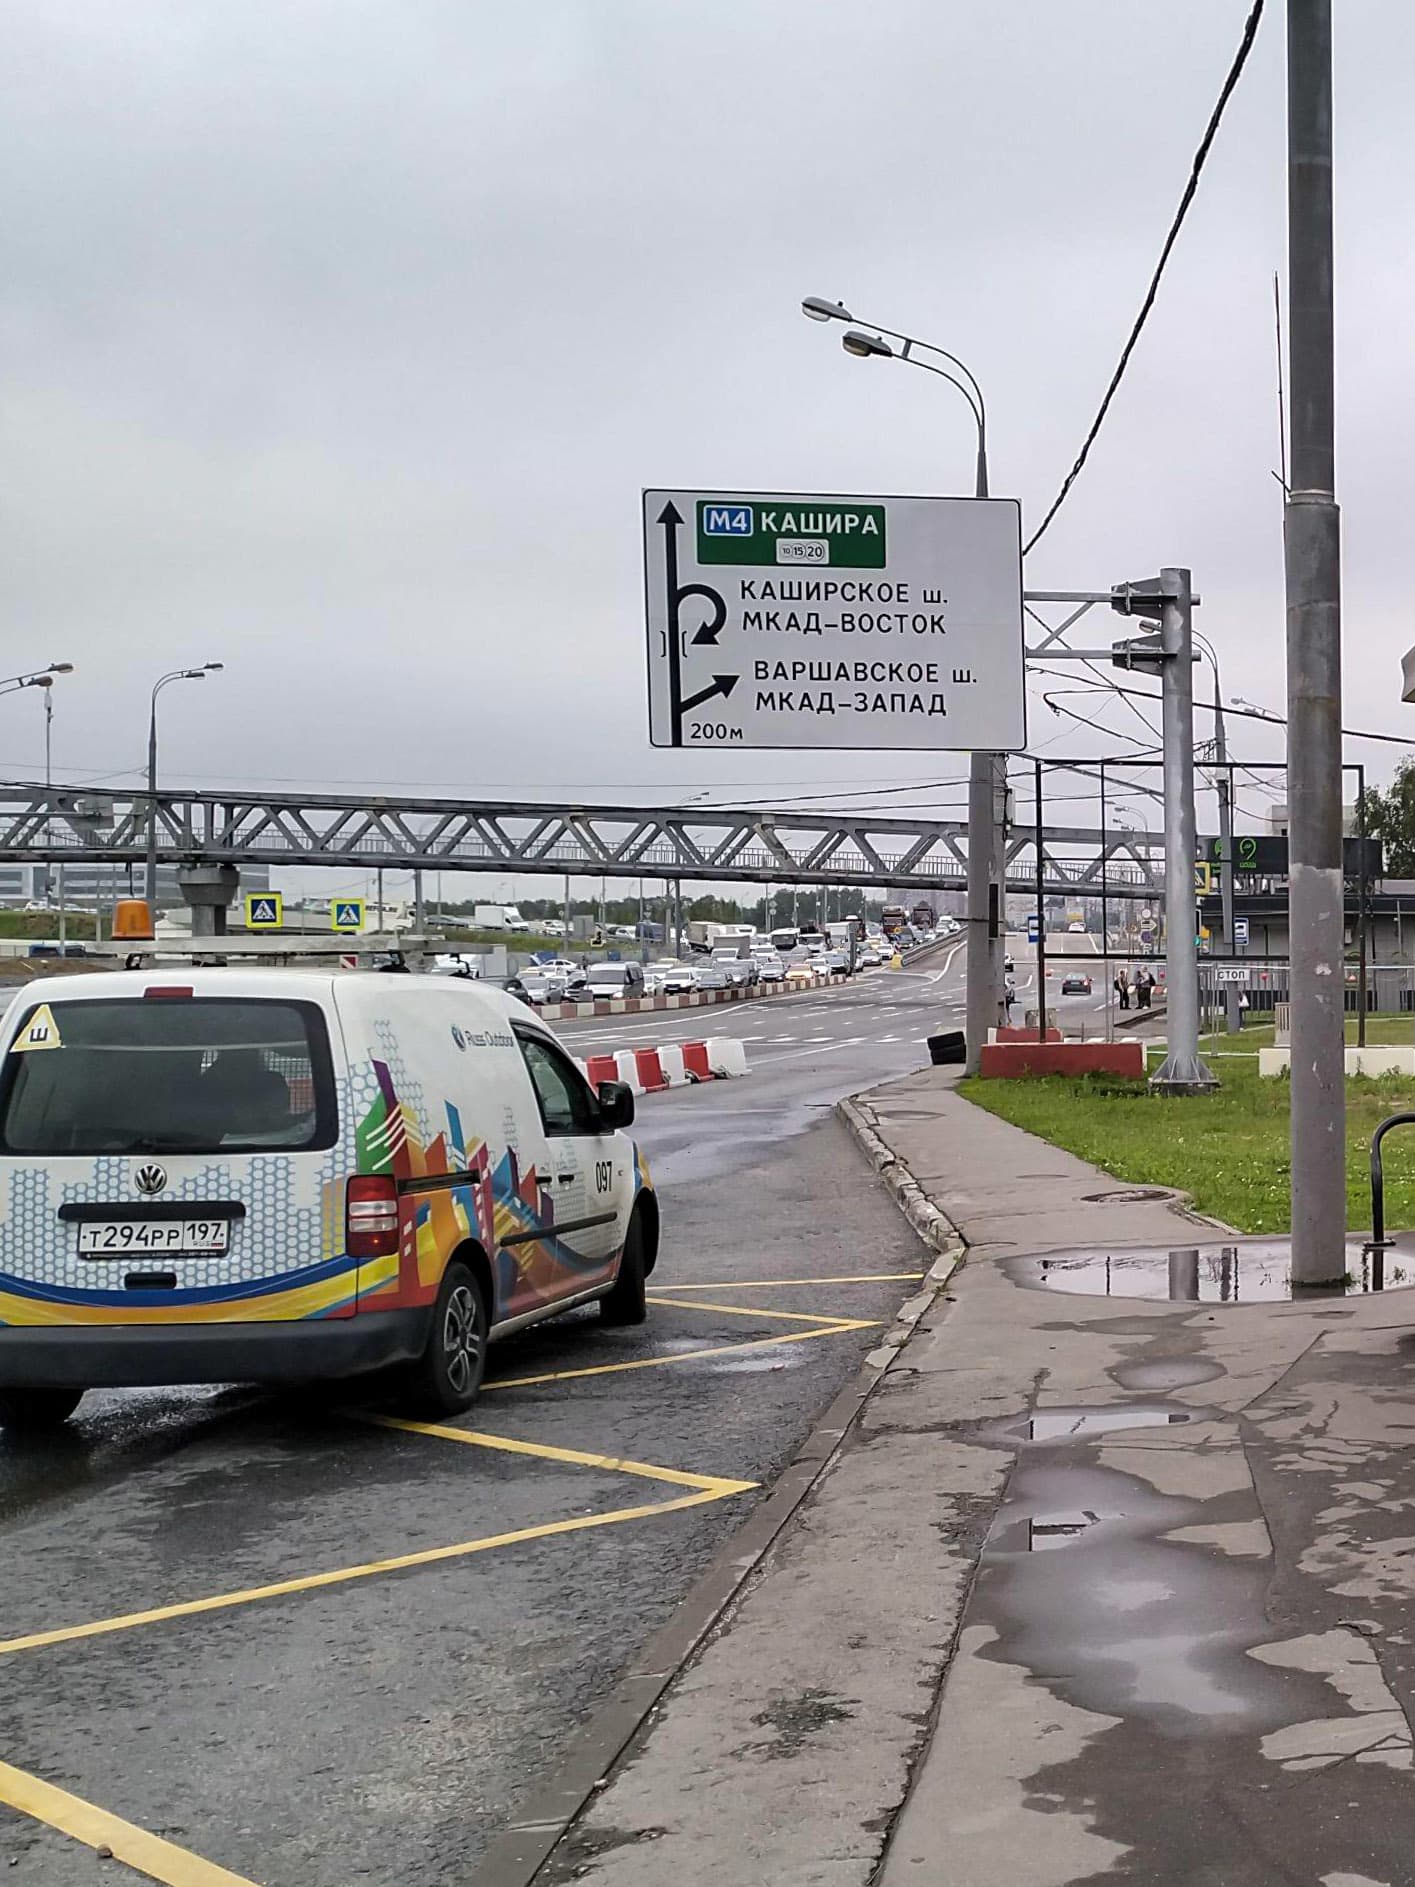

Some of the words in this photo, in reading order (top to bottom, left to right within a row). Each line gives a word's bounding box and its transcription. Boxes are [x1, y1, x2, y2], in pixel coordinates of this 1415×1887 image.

[709, 510, 748, 531] М4
[761, 511, 879, 535] КАШИРА
[794, 546, 804, 556] 15
[807, 546, 823, 558] 20
[740, 580, 909, 603] КАШИРСКОЕ
[923, 589, 949, 605] ш.
[741, 611, 947, 635] МКАД-ВОСТОК
[754, 660, 939, 683] ВАРШАВСКОЕ
[952, 669, 978, 684] ш.
[755, 692, 947, 716] МКАД-ЗАПАД
[690, 723, 744, 741] 200м
[1217, 970, 1245, 980] СТОП
[29, 1027, 49, 1042] Ш
[596, 1161, 612, 1193] 097
[187, 1223, 222, 1241] 197
